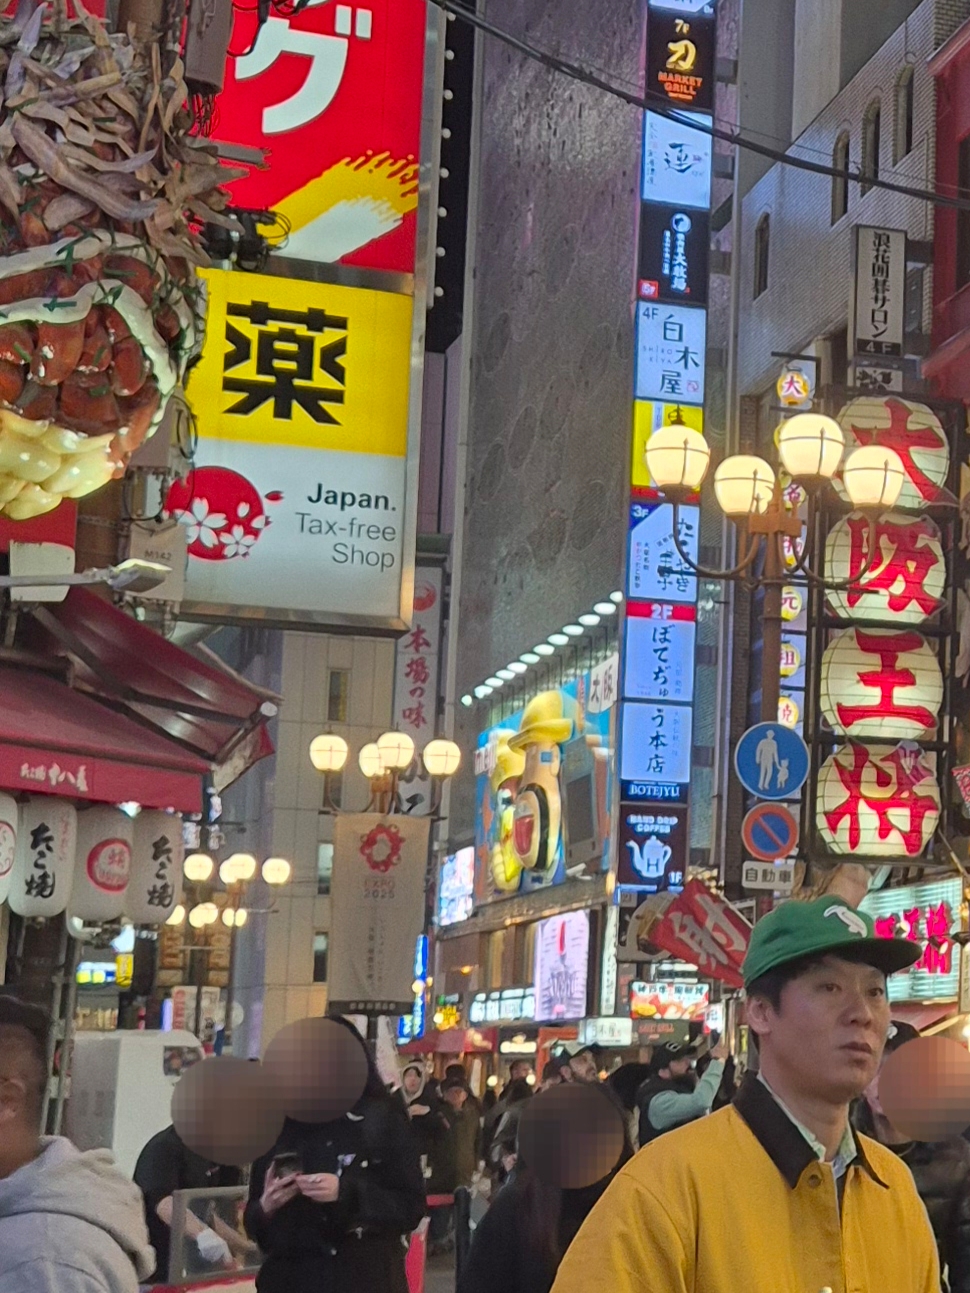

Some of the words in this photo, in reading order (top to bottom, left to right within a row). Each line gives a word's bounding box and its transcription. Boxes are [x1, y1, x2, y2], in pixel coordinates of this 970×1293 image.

[658, 70, 703, 87] MARKET
[664, 81, 697, 95] GRILL
[642, 307, 659, 320] 4F
[222, 300, 349, 426] 薬
[659, 314, 700, 396] 白木屋
[307, 482, 397, 512] Japan.
[632, 504, 649, 517] 3F
[295, 512, 396, 542] Tax-free
[331, 541, 396, 572] Shop
[651, 604, 673, 620] 2F
[402, 624, 430, 729] 本場の味
[629, 784, 680, 797] BOTEJYU
[636, 824, 670, 833] COFFEE
[25, 822, 55, 898] たこ焼
[147, 835, 175, 908] たこ焼
[745, 866, 793, 884] 自動車
[363, 889, 396, 899] 2025
